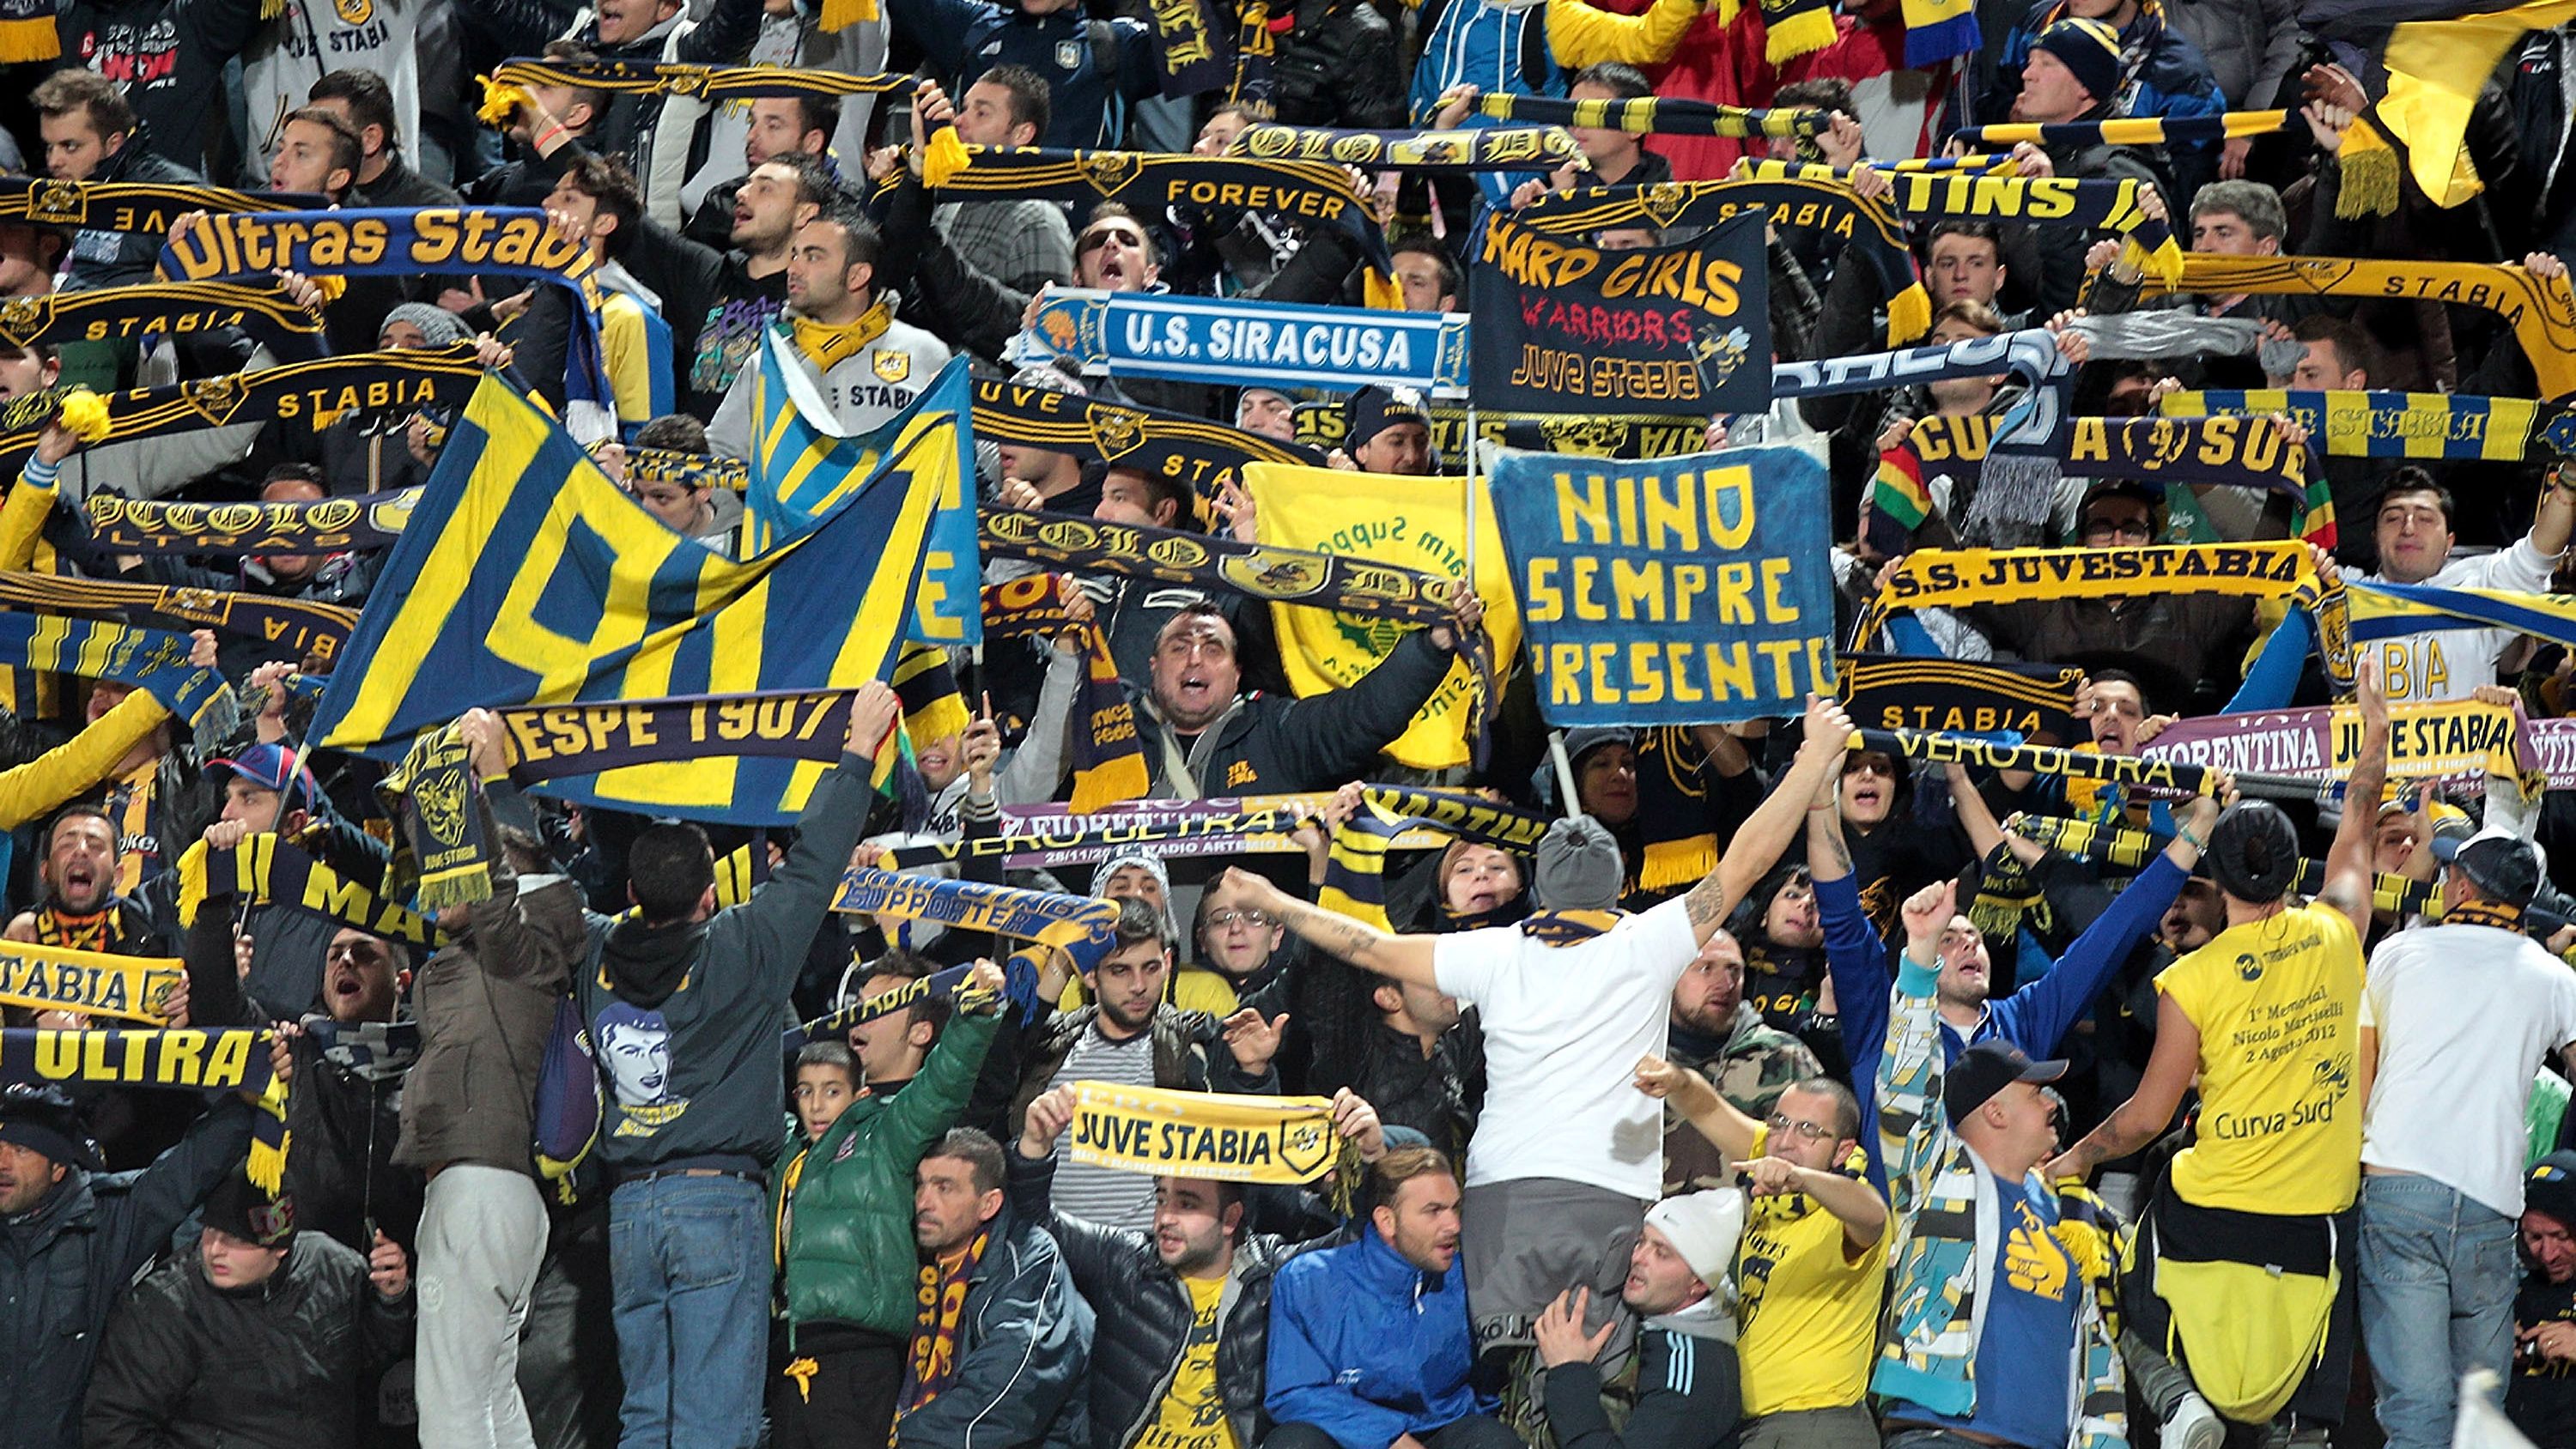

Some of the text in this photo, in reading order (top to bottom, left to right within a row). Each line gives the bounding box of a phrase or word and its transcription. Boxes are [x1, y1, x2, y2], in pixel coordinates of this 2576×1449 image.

[1168, 179, 1346, 220] FOREVER
[179, 213, 387, 279] Ultras
[1483, 211, 1744, 317] HARD GIRLS
[86, 311, 244, 341] STABIA
[1521, 293, 1693, 350] WARRIORS
[2385, 276, 2524, 328] STABIA
[1125, 314, 1200, 355] U.S.
[1208, 318, 1411, 371] SIRACUSA
[277, 378, 436, 419] STABIA
[976, 380, 1065, 412] UVE
[1910, 416, 2109, 464] CUA
[1553, 465, 1755, 552] NINO
[1528, 557, 1800, 625] SEMPRE
[1891, 547, 2298, 598] S.S. JUVESTABIA
[691, 692, 841, 743] 1907
[1882, 706, 2041, 732] STABIA
[2336, 721, 2407, 762] JUE
[1894, 731, 2177, 788] VERO ULTRA
[0, 955, 128, 1013] TABIA
[1076, 1112, 1272, 1166] JUVE STABIA
[2215, 1092, 2334, 1140] Curva Sud
